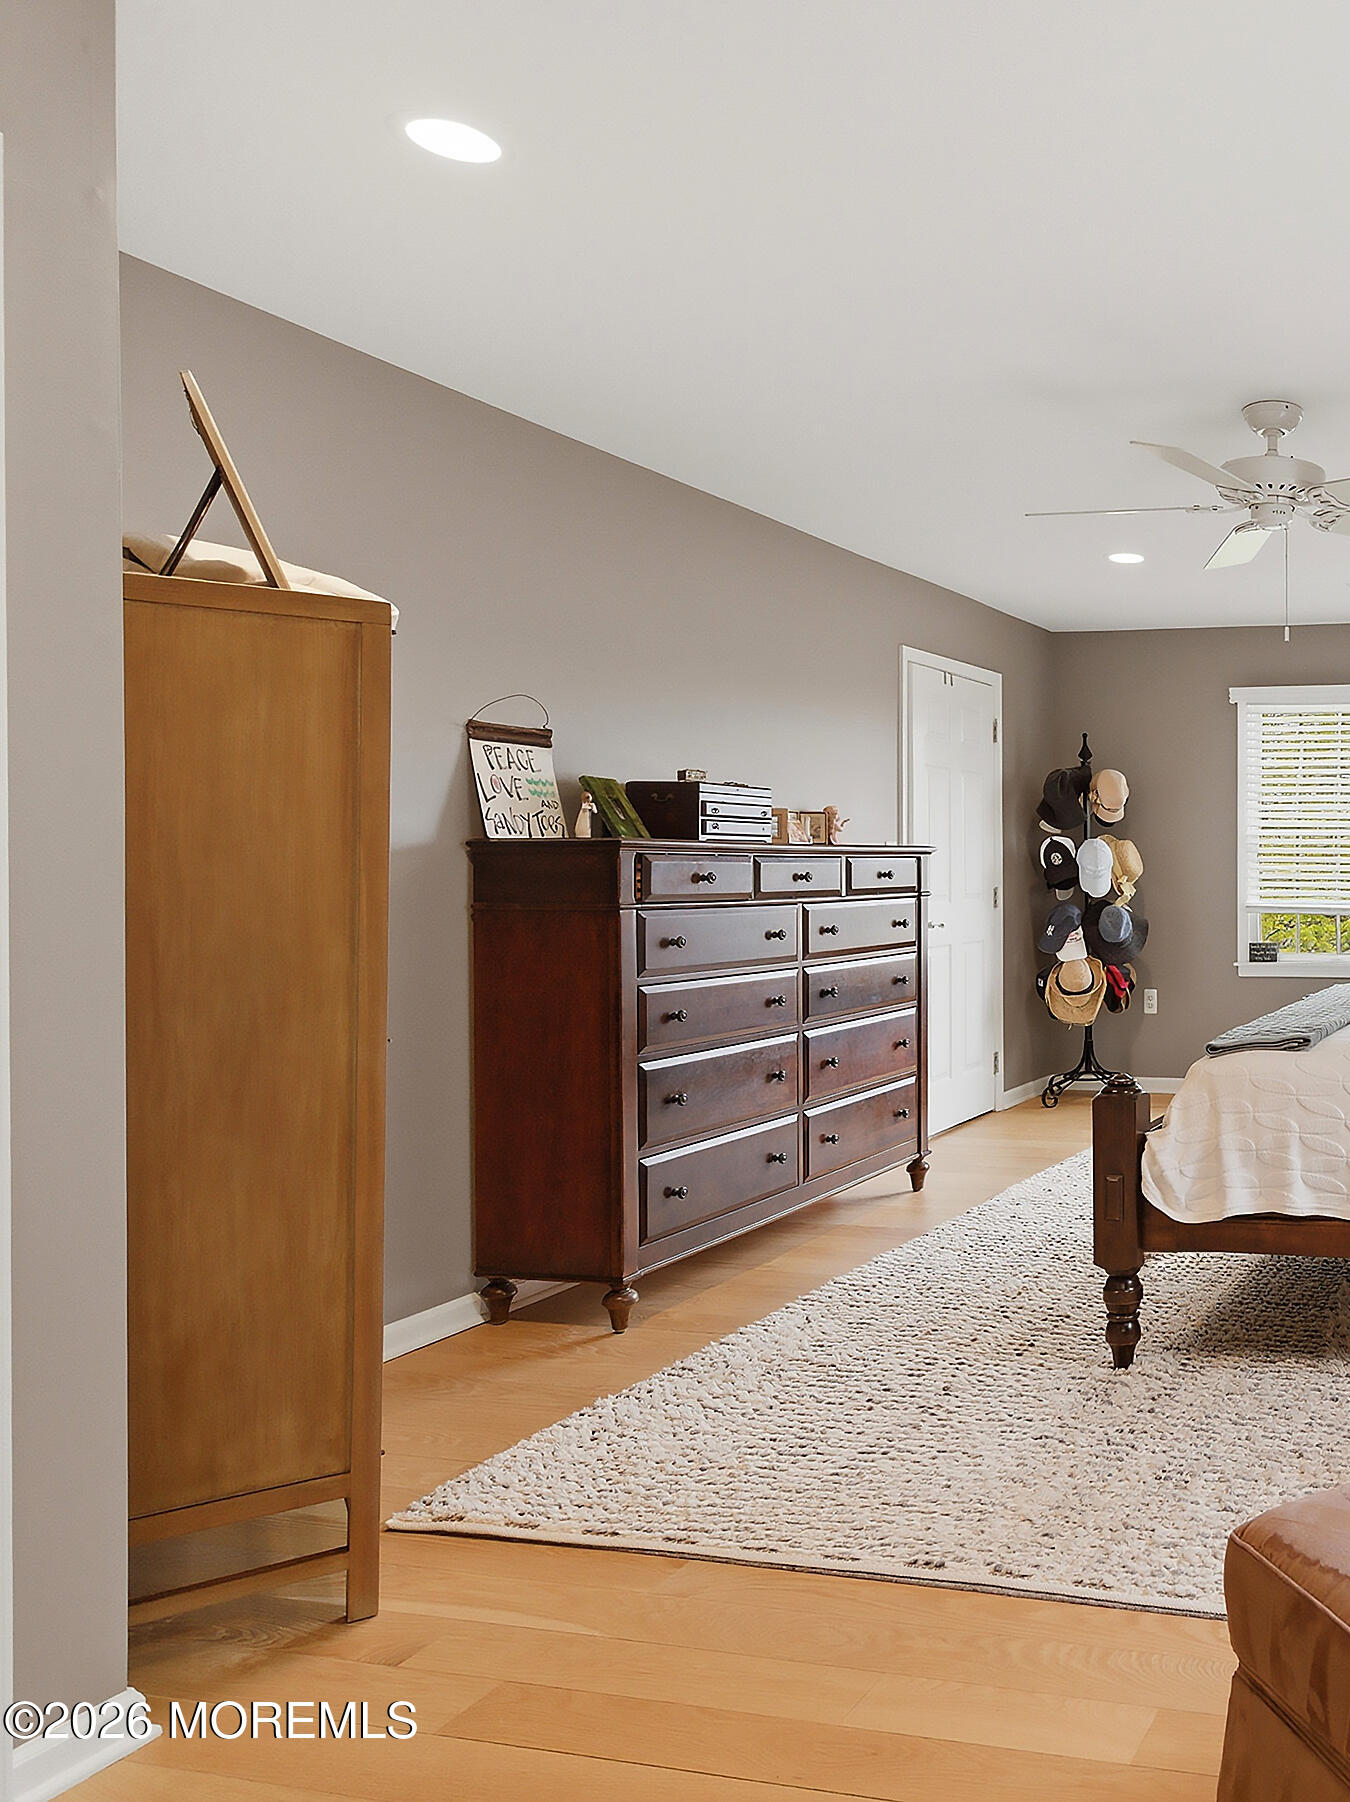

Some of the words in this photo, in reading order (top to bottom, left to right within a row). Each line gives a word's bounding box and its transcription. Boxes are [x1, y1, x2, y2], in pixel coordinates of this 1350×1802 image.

[483, 744, 541, 773] PEACE
[476, 773, 529, 803] LOVE
[541, 799, 559, 810] AND
